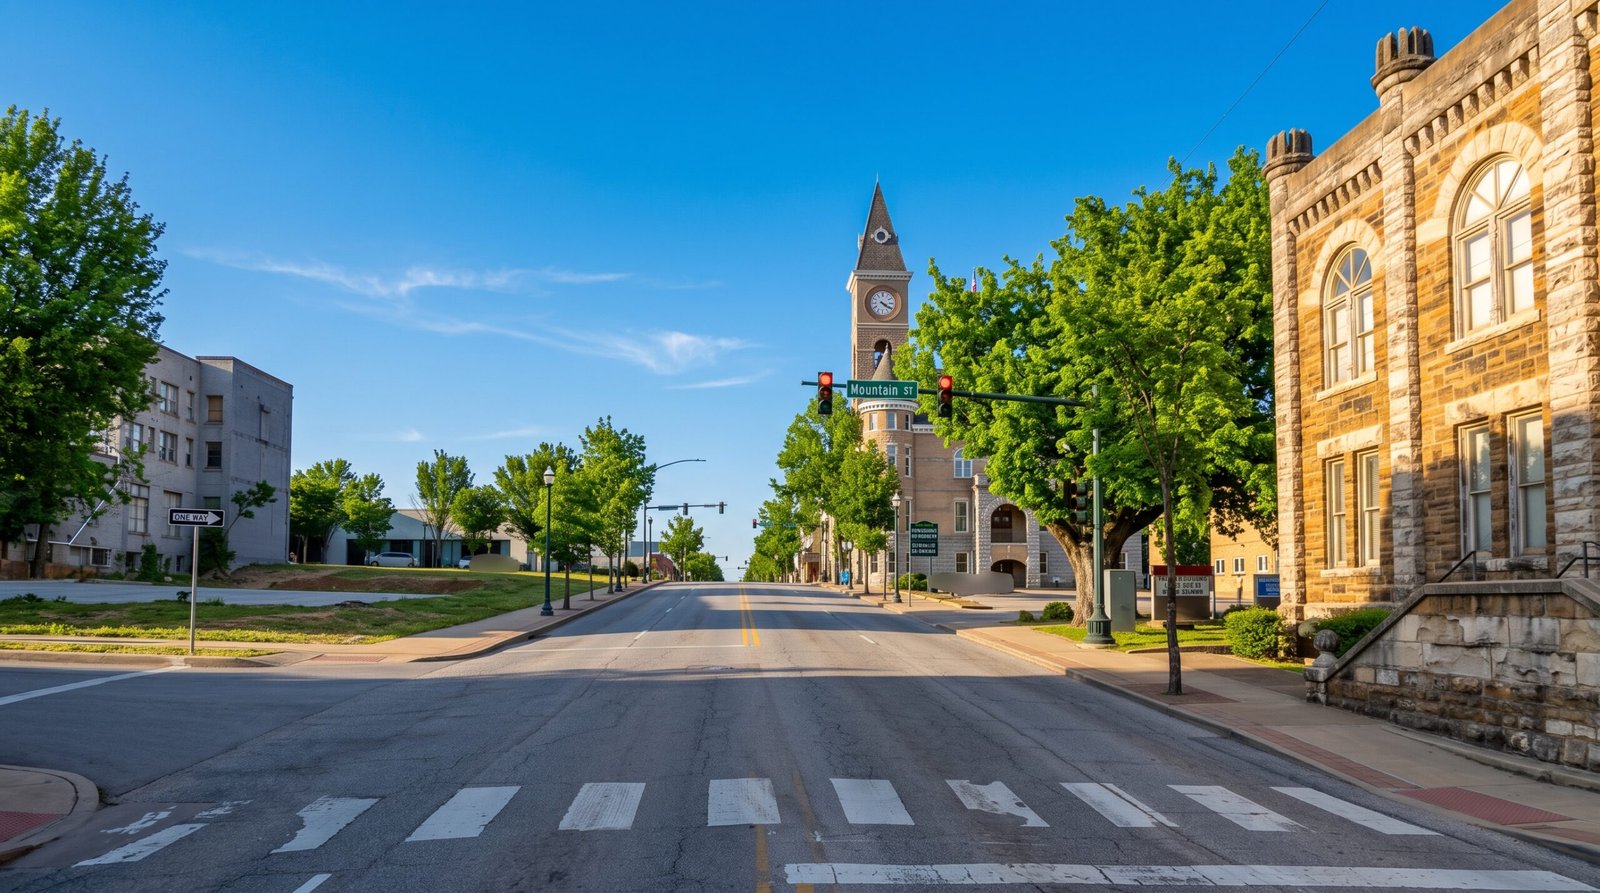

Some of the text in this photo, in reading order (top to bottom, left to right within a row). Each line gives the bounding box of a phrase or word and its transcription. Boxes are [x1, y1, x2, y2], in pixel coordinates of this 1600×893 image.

[850, 383, 913, 396] Mountain ST
[174, 513, 208, 522] ONE WAY
